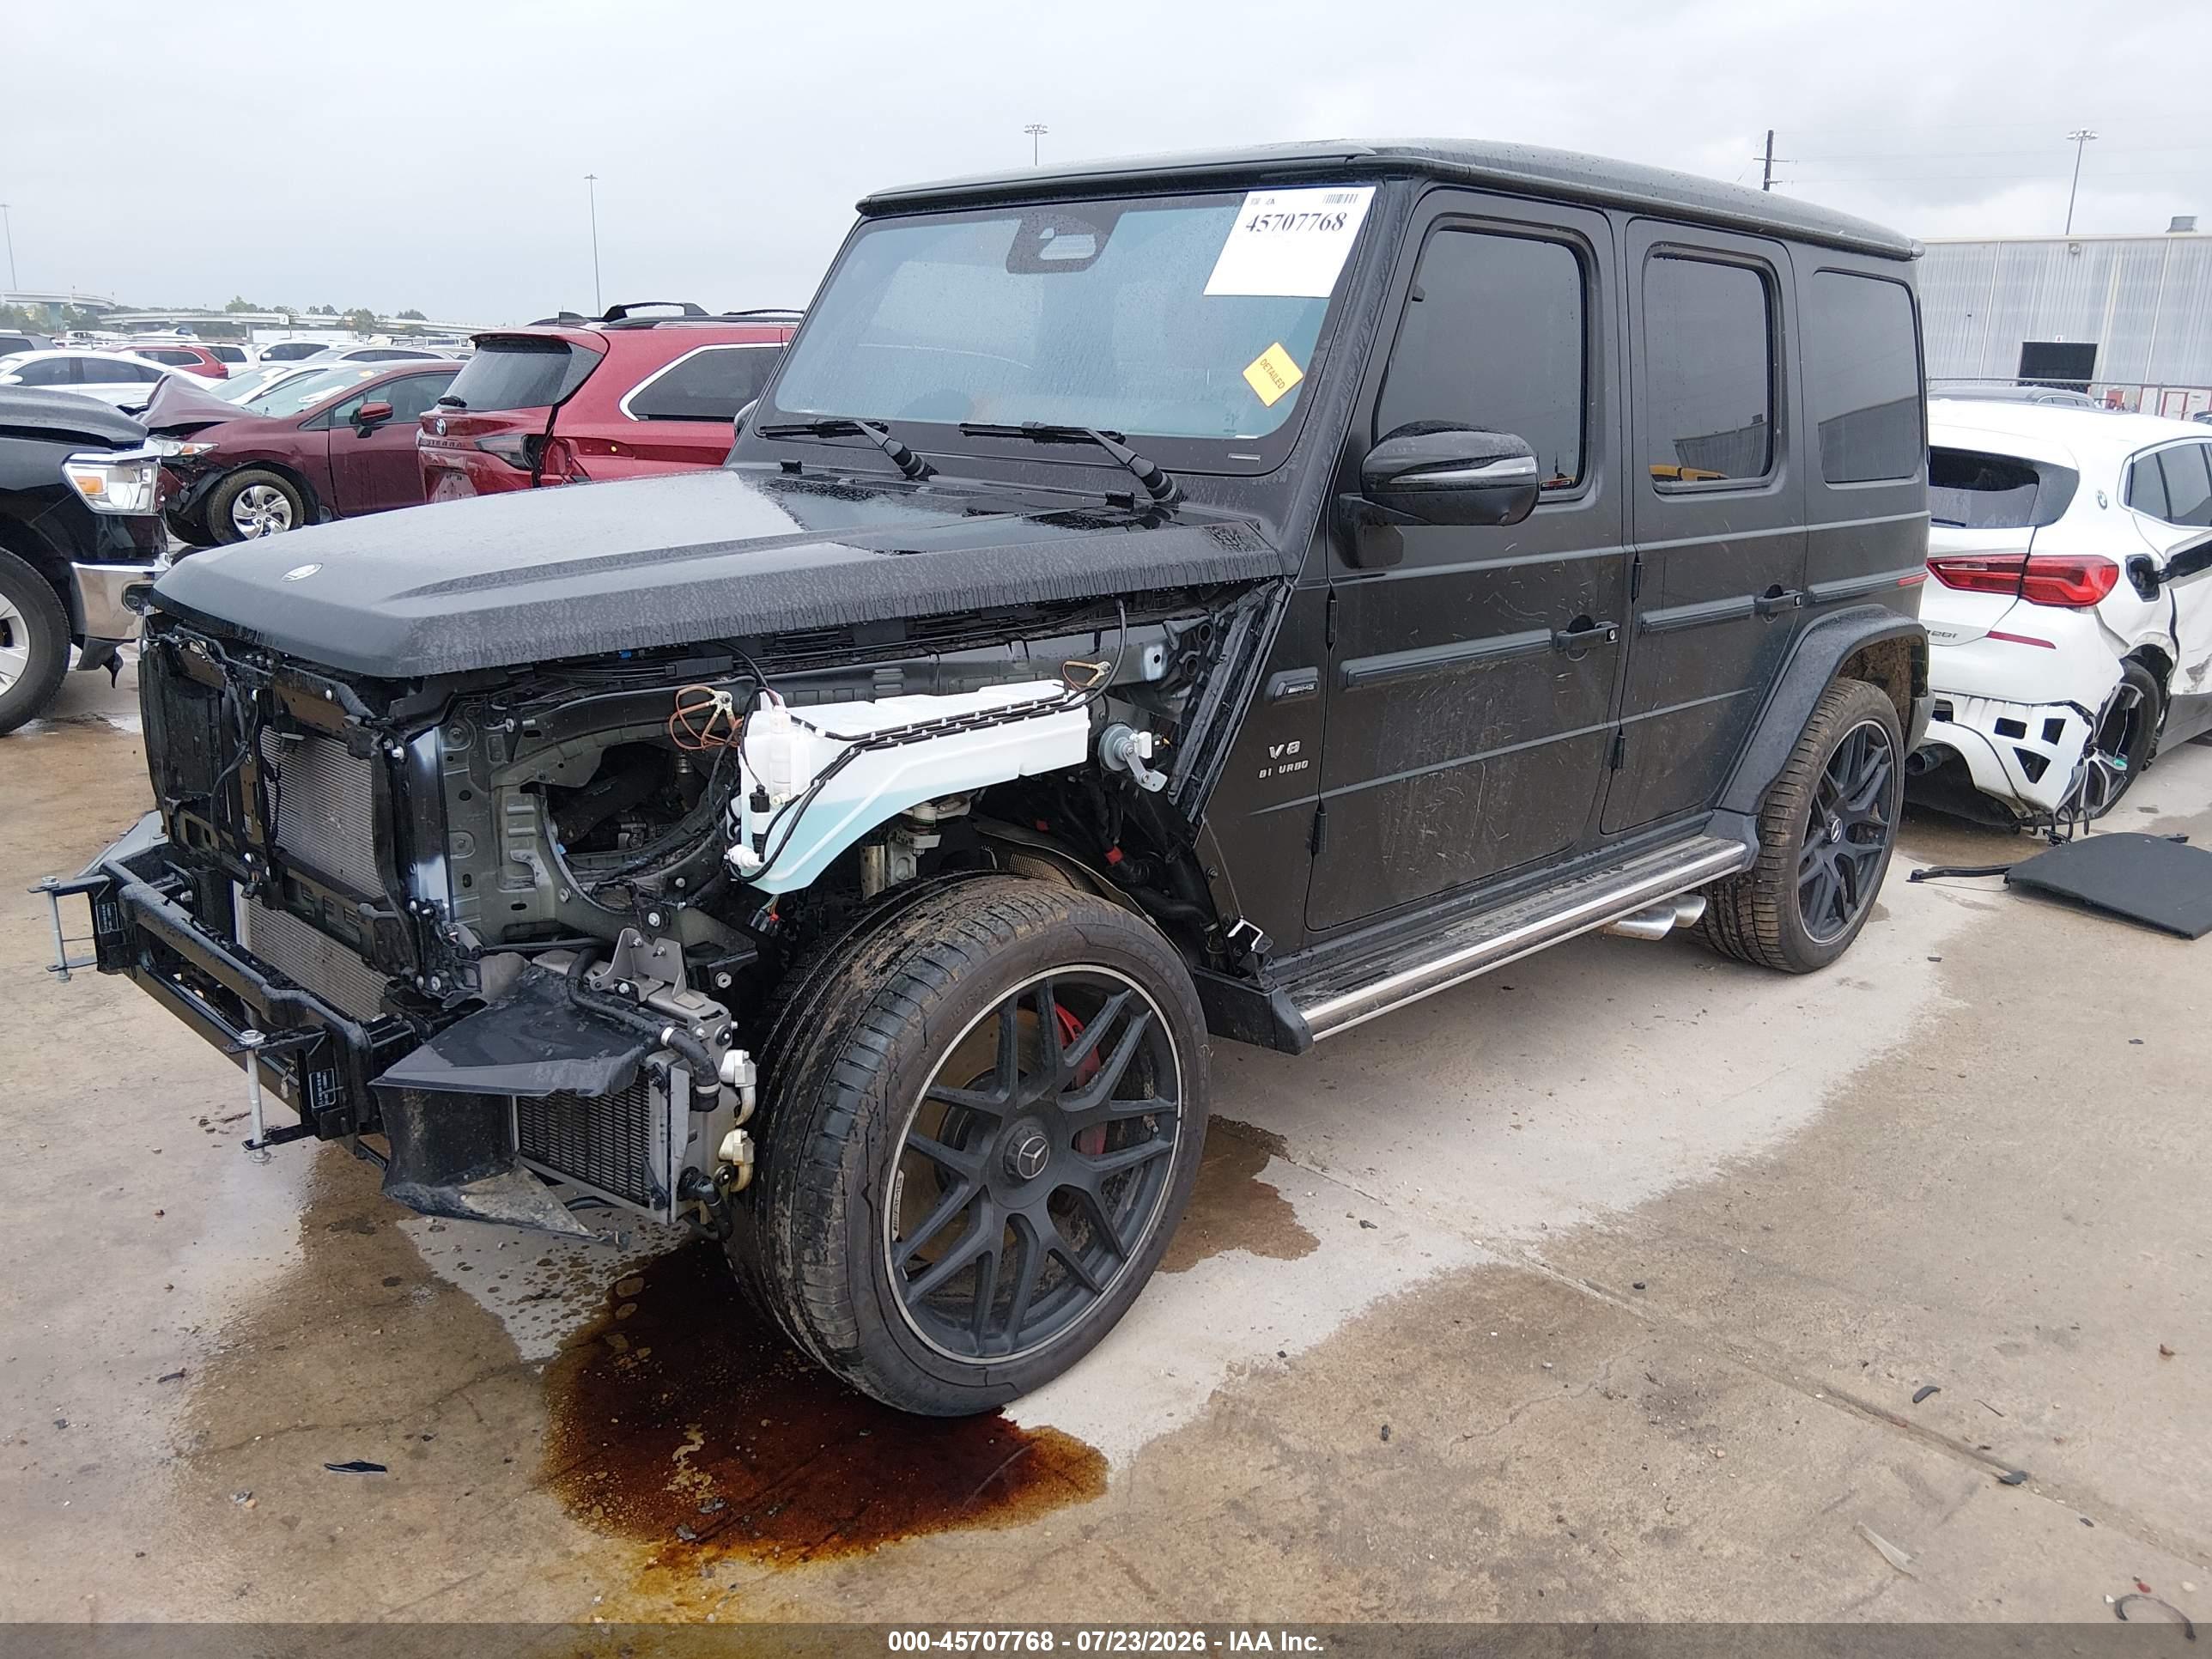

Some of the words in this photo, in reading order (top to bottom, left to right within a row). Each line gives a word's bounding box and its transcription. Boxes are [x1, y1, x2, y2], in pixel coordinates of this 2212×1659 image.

[1245, 211, 1347, 233] 45707768
[1259, 357, 1286, 390] DETAILED
[1268, 740, 1301, 760] V8
